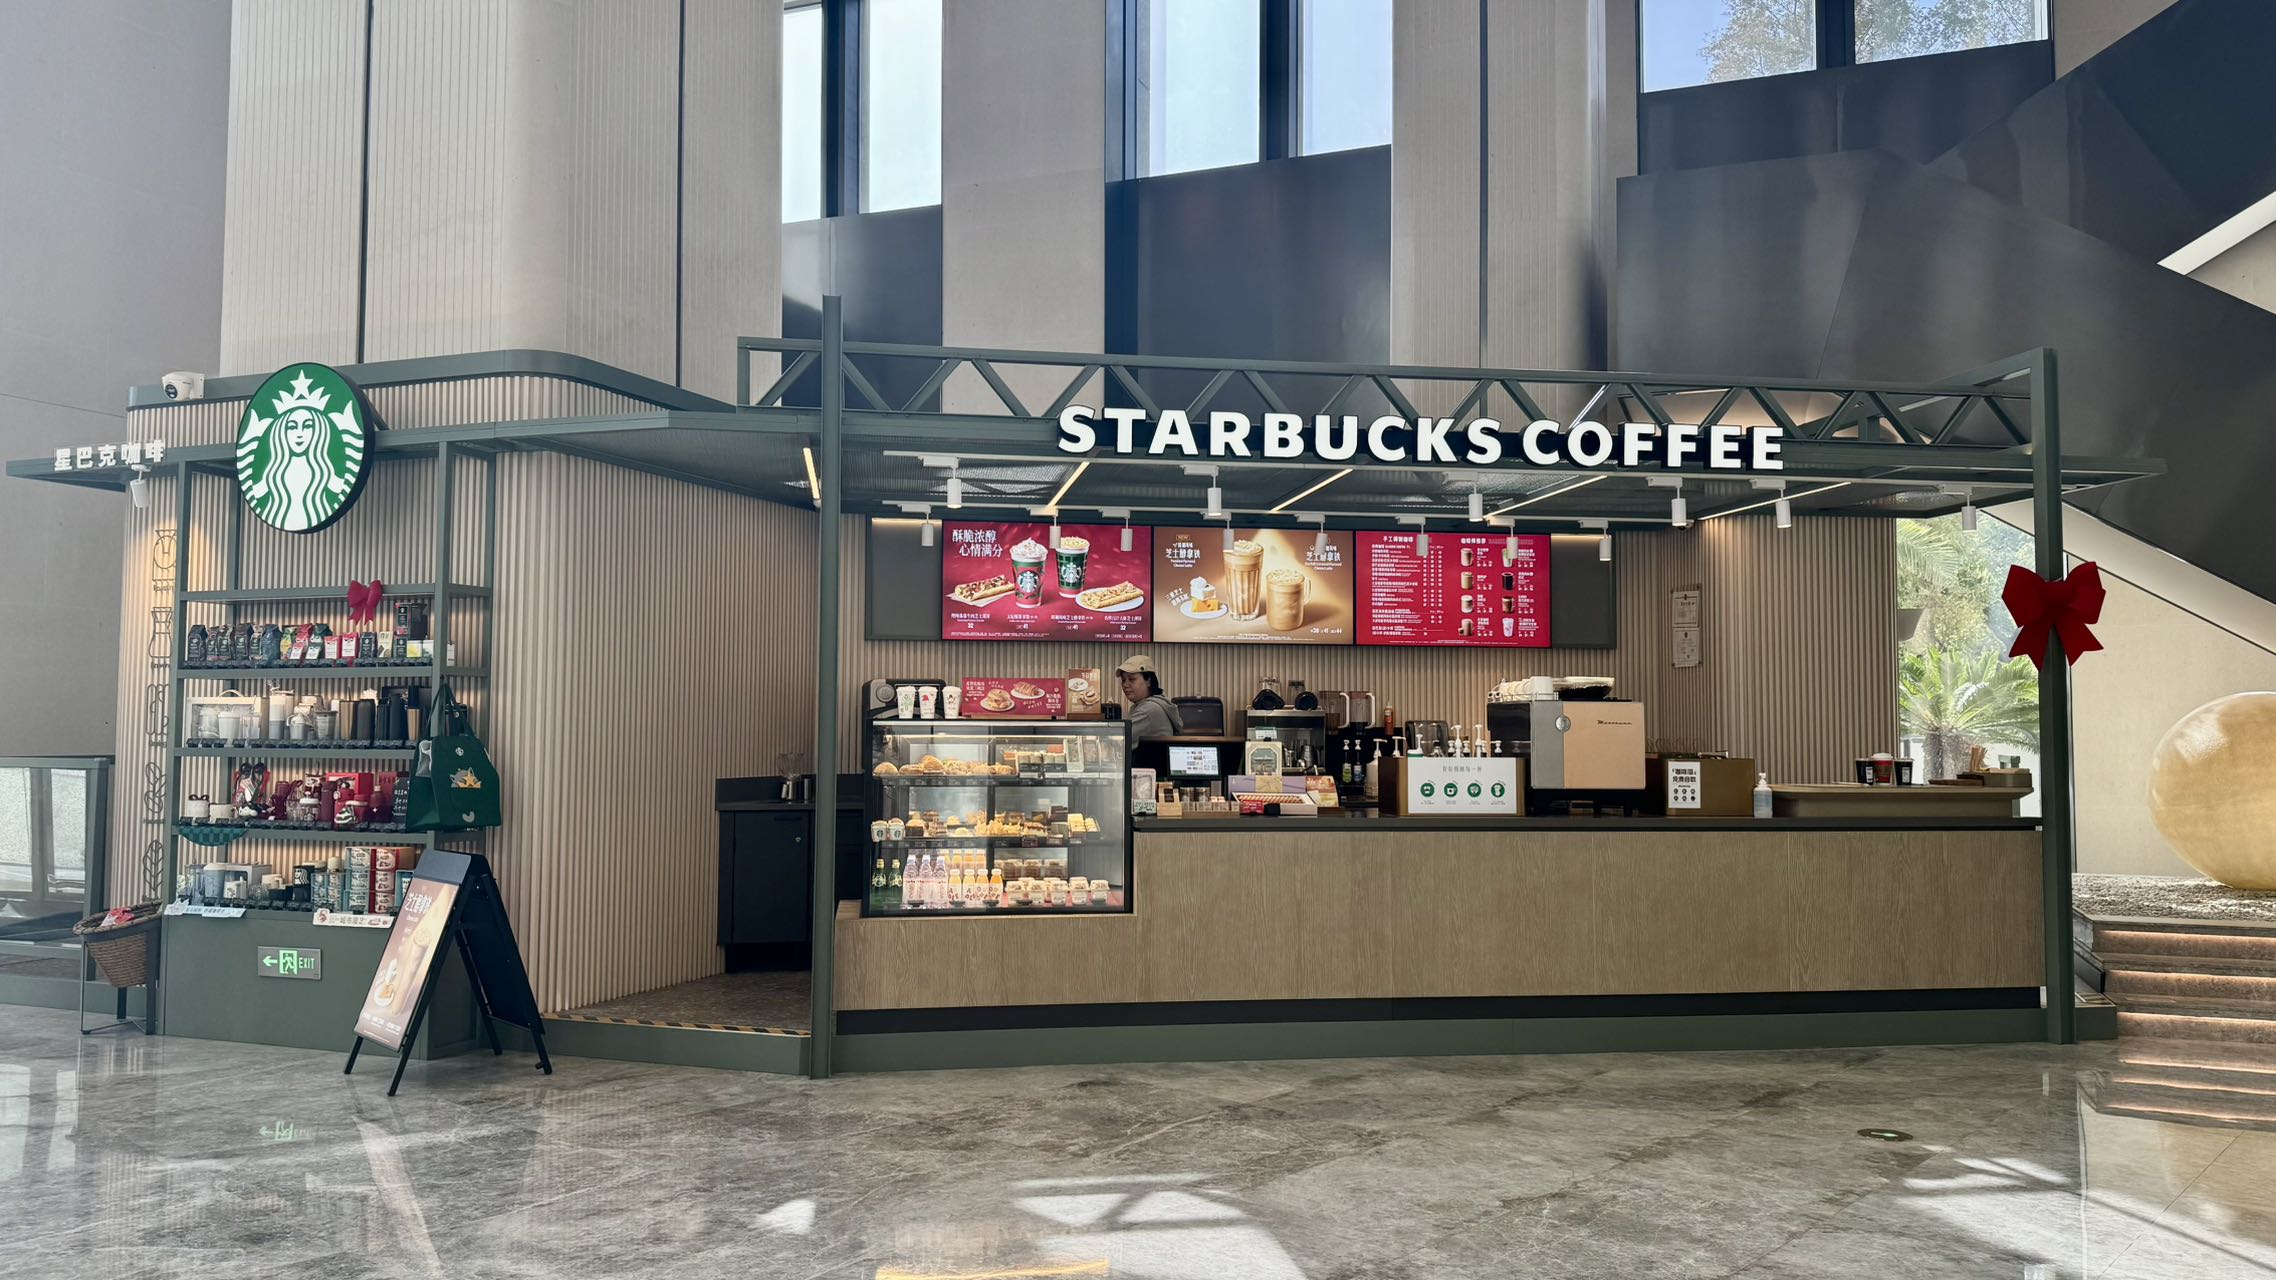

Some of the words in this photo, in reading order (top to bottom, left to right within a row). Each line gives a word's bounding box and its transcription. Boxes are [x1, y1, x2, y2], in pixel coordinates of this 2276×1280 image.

[1057, 404, 1502, 465] STARBUCKS
[1522, 418, 1784, 471] COFFEE
[54, 438, 165, 472] 星巴克咖啡
[952, 528, 997, 544] 酥脆浓醇
[959, 543, 1003, 558] 心情满分
[298, 957, 315, 969] EXIT
